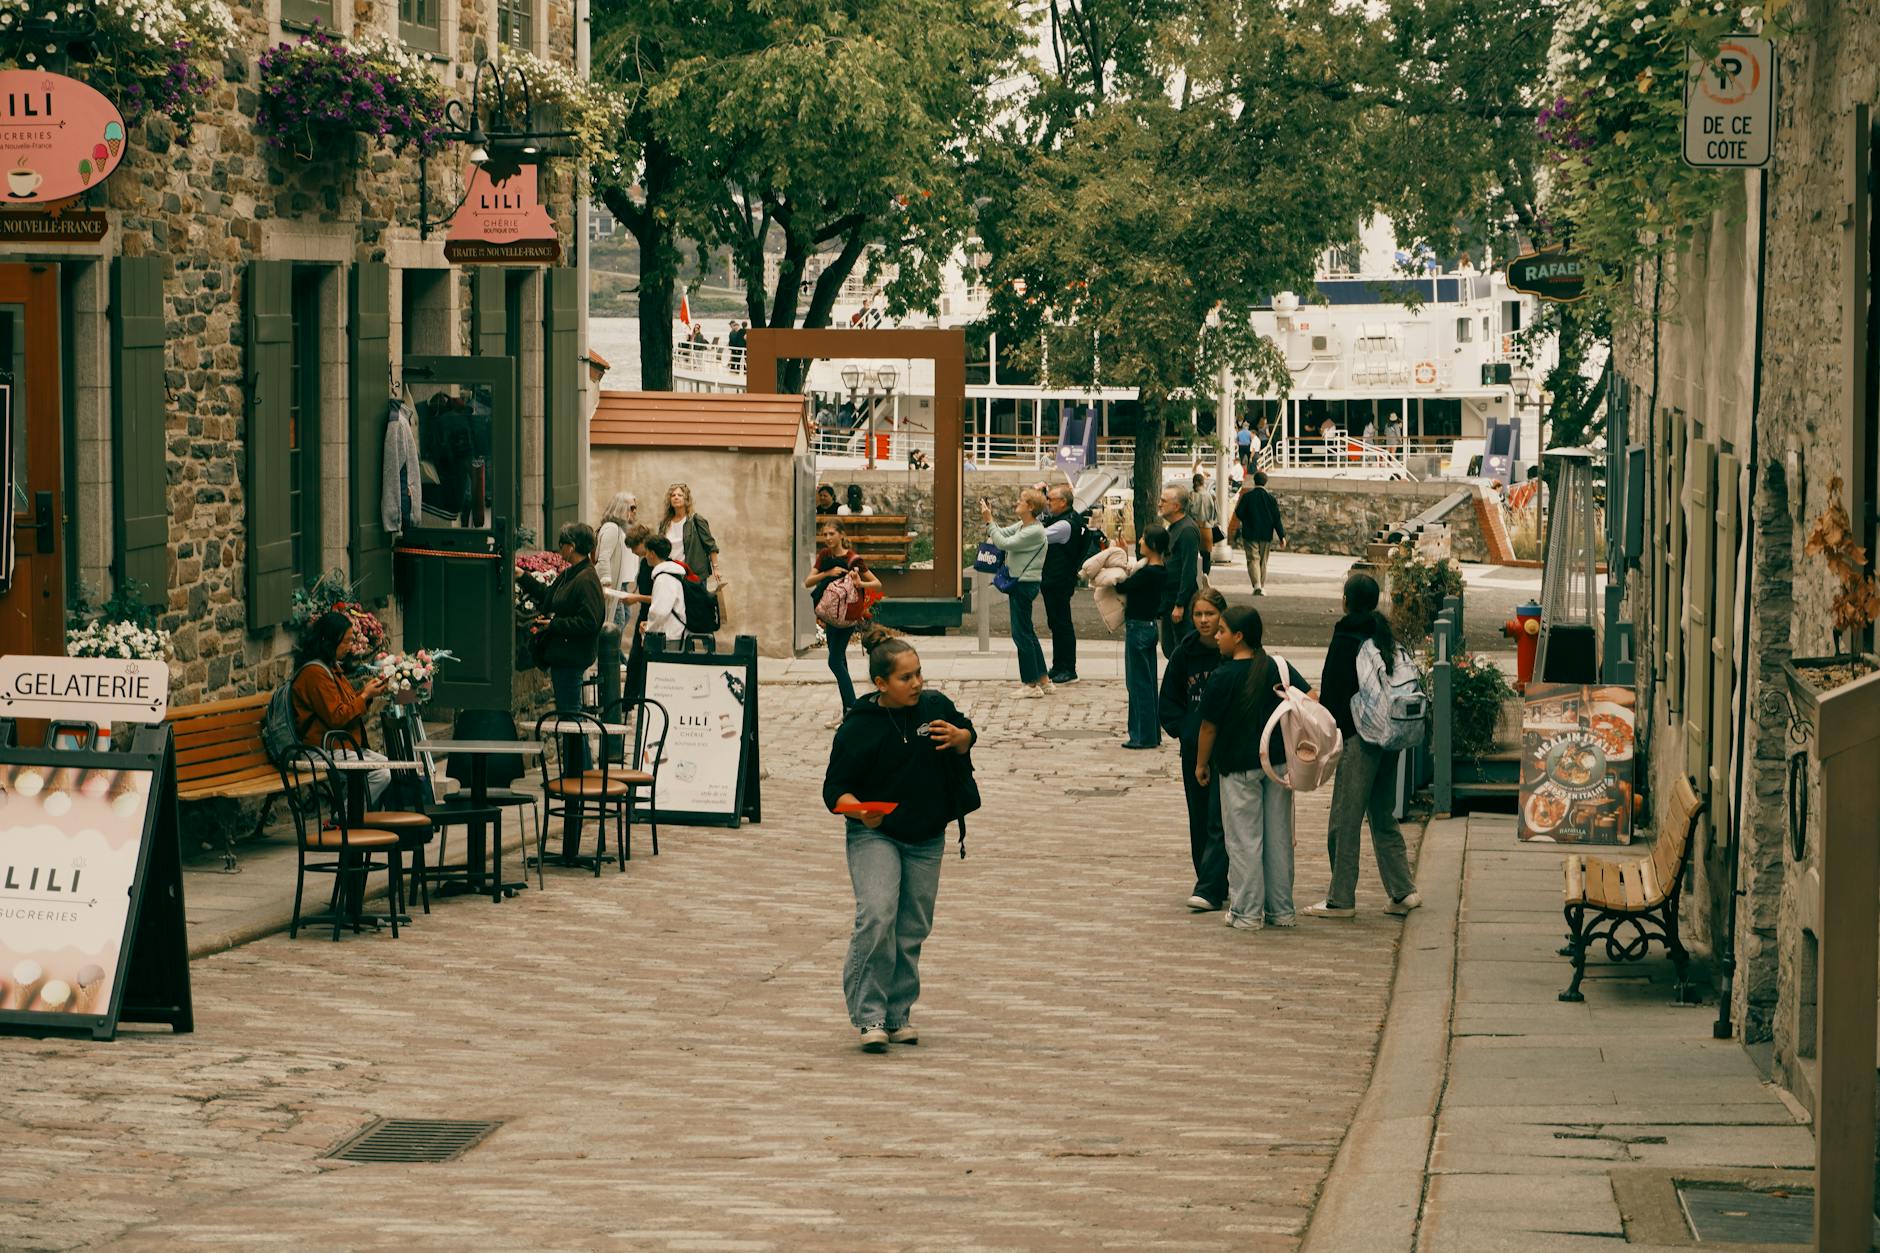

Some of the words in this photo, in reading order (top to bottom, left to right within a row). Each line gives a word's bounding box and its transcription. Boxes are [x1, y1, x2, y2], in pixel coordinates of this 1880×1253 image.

[0, 93, 52, 117] ILI
[1703, 116, 1725, 135] DE
[1731, 116, 1753, 135] CE
[0, 131, 52, 141] CRERIES
[5, 142, 53, 151] Nouvelle-France
[481, 194, 521, 209] LILI
[3, 219, 102, 235] NOUVELLE-FRANCE
[452, 247, 478, 257] TRAITE
[486, 246, 553, 258] NOUVELLE-FRANCE
[977, 550, 997, 565] Indigo
[15, 672, 150, 699] GELATERIE
[680, 715, 707, 726] LILI
[1534, 735, 1565, 759] MEAL
[1566, 732, 1581, 743] IN
[1583, 733, 1617, 756] ITALY
[4, 866, 81, 893] LILI
